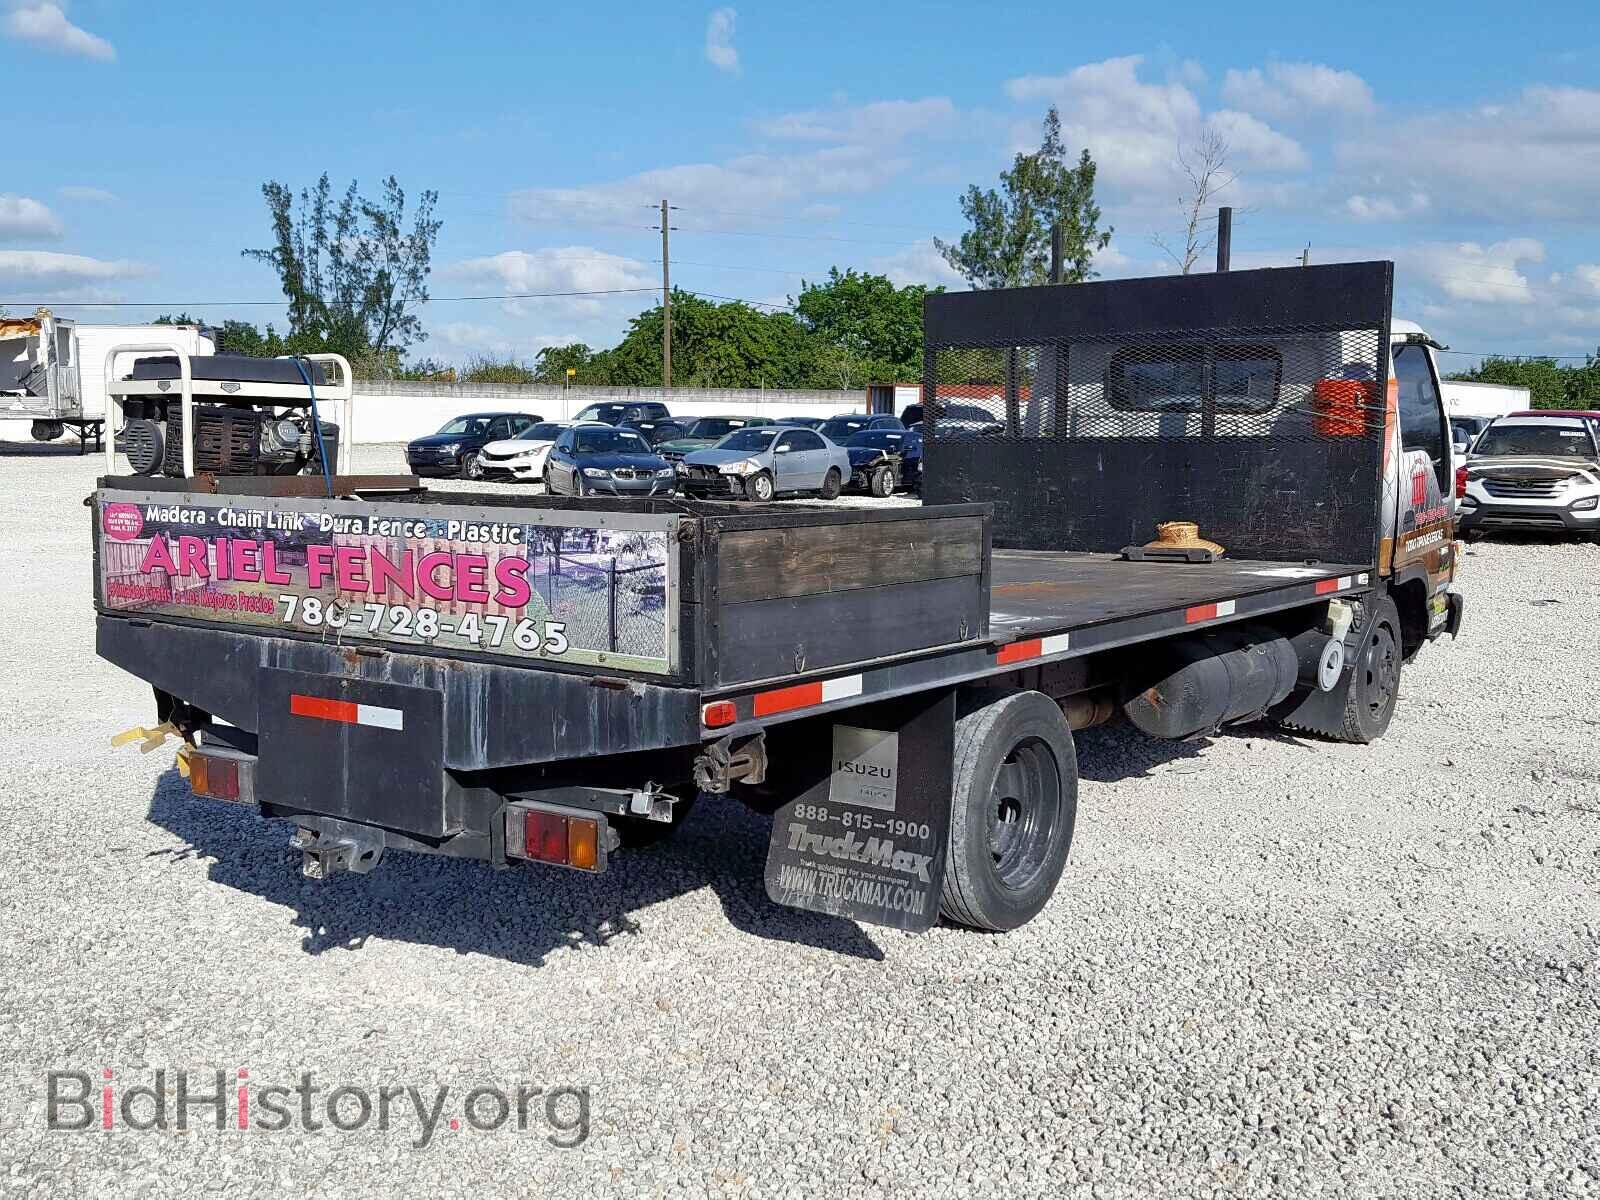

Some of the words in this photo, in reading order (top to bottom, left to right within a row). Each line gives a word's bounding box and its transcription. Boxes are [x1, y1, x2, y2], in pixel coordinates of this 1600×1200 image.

[146, 505, 206, 525] Madera
[217, 508, 262, 528] Chain
[267, 512, 304, 532] Link
[319, 514, 362, 534] Dura
[368, 516, 426, 538] Fence
[447, 520, 521, 545] Plastic
[140, 531, 292, 585] ARIEL
[307, 544, 531, 608] FENCES
[202, 590, 238, 613] Mejores
[239, 591, 275, 614] Precios
[278, 593, 569, 655] 786-728-4765
[838, 760, 892, 779] ISUZU
[794, 803, 931, 840] 888-815-1900
[787, 822, 933, 884] TruckMax
[780, 863, 926, 915] WWW.TRUCKMAX.COM
